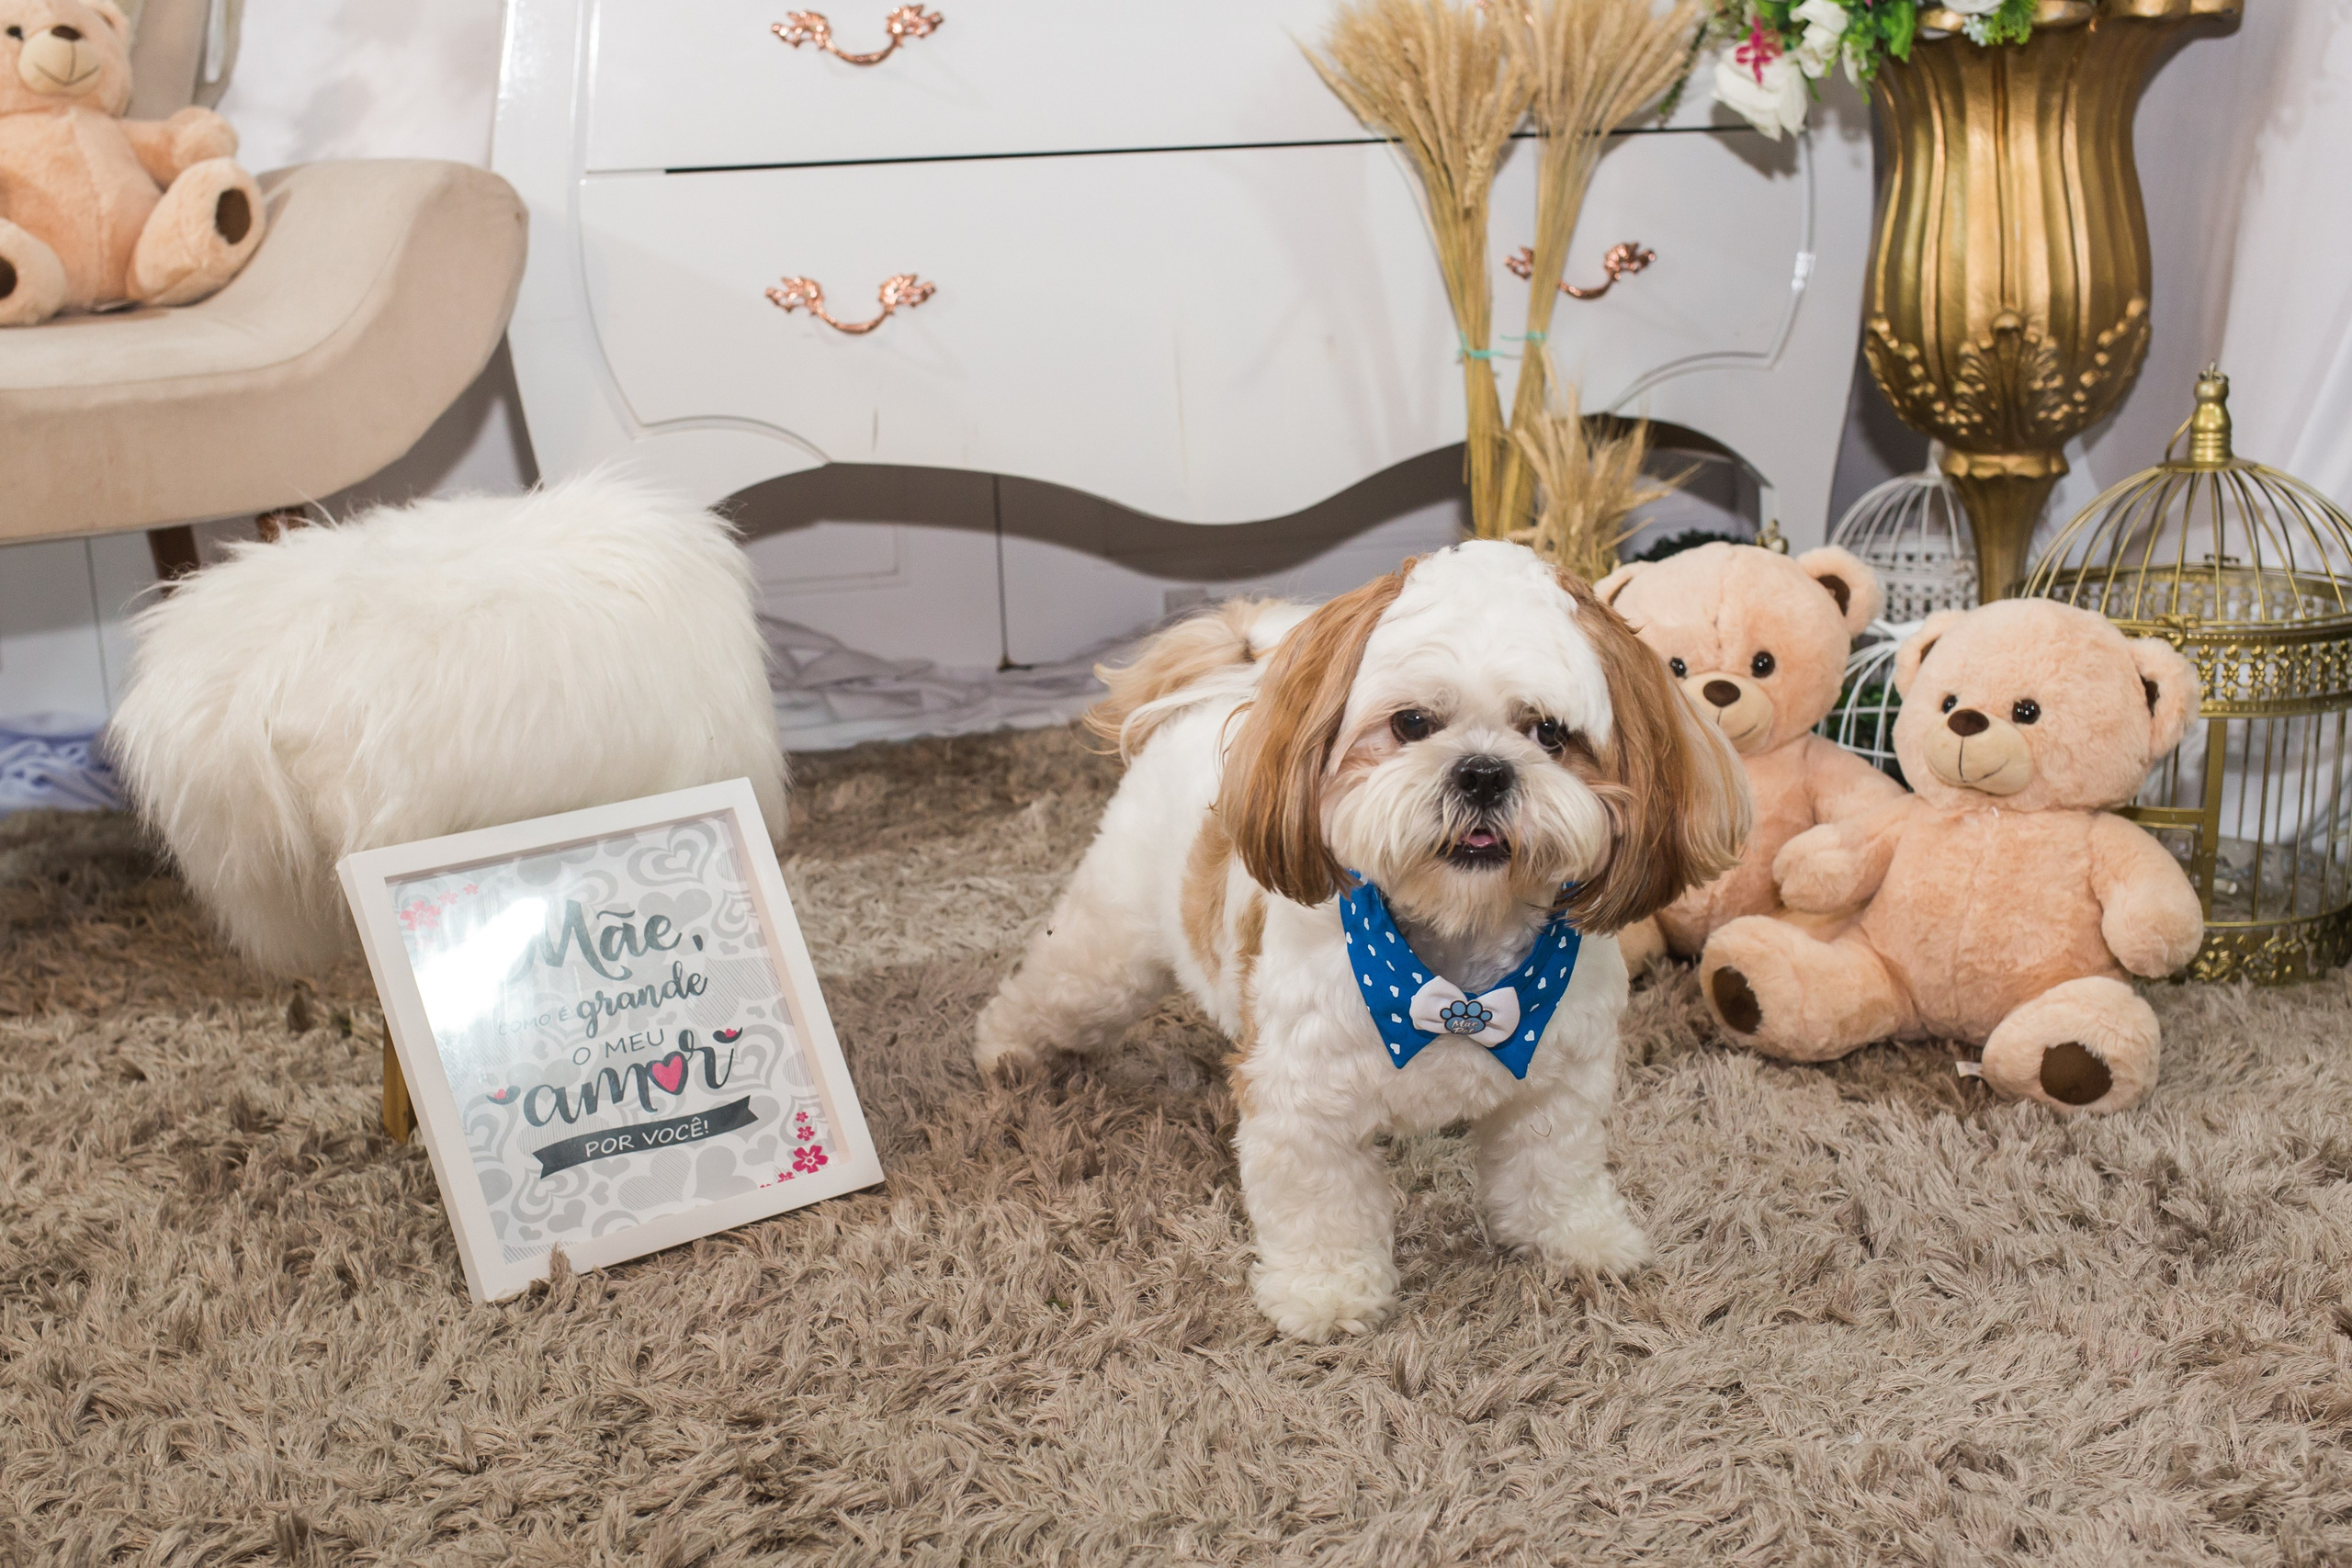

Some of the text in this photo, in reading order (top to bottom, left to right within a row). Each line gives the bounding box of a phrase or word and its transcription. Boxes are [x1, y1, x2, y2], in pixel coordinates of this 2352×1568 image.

[511, 899, 704, 980] Mãe,
[498, 961, 708, 1039] COMO É grande
[572, 1029, 666, 1066] O MEU
[583, 1116, 710, 1158] POR VOCÊ!
